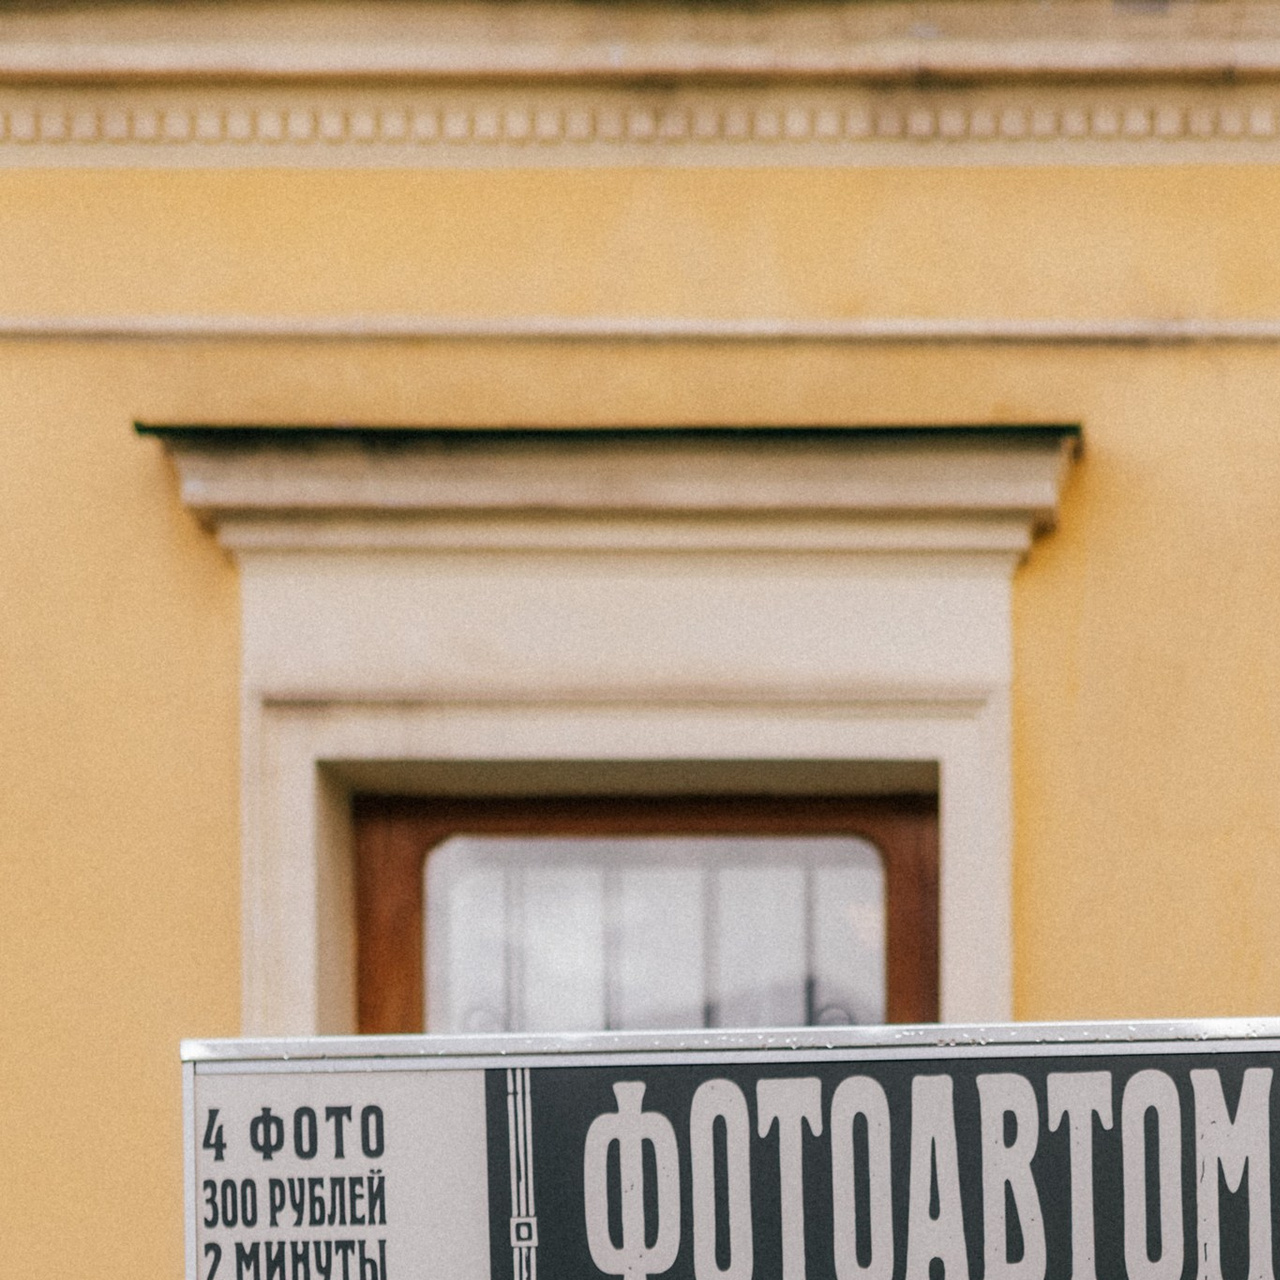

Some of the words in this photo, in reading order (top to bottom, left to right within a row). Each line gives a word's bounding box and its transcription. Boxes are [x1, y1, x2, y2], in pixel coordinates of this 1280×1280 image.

[203, 1109, 227, 1161] 4
[249, 1105, 386, 1161] ФОТО
[203, 1178, 258, 1228] 300
[268, 1169, 389, 1227] РУБЛЕЙ
